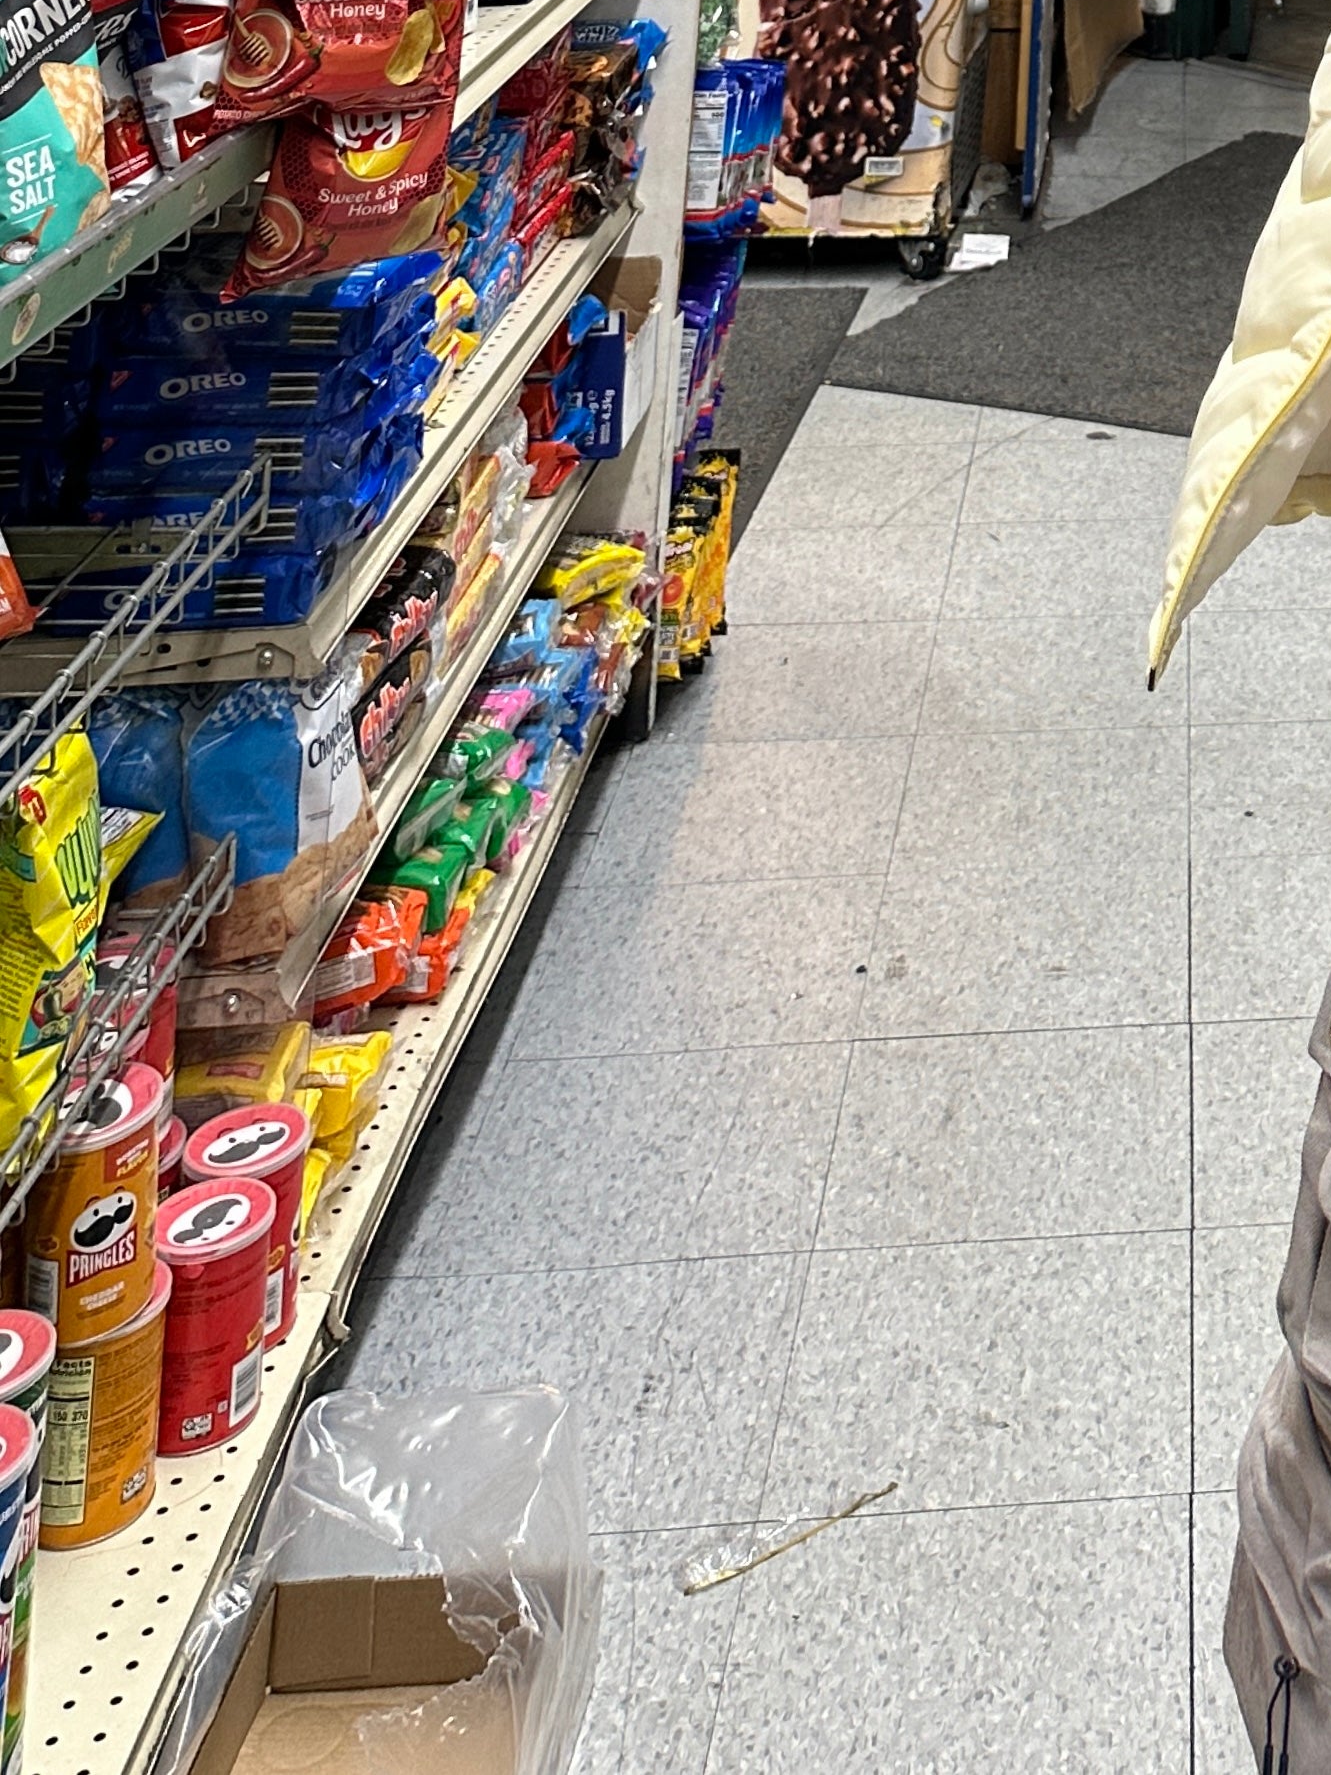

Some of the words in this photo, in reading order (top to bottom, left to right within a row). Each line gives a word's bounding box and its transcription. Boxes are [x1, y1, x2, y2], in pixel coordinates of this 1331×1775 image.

[330, 3, 386, 20] Honey
[6, 145, 56, 188] SEA
[10, 175, 56, 215] SALT
[318, 187, 371, 204] Sweet
[388, 172, 428, 193] Spicy
[348, 196, 399, 217] Honey
[182, 309, 270, 333] OREO
[159, 372, 247, 401] OREO
[144, 438, 232, 467] OREO
[69, 1230, 136, 1284] PRINGLES
